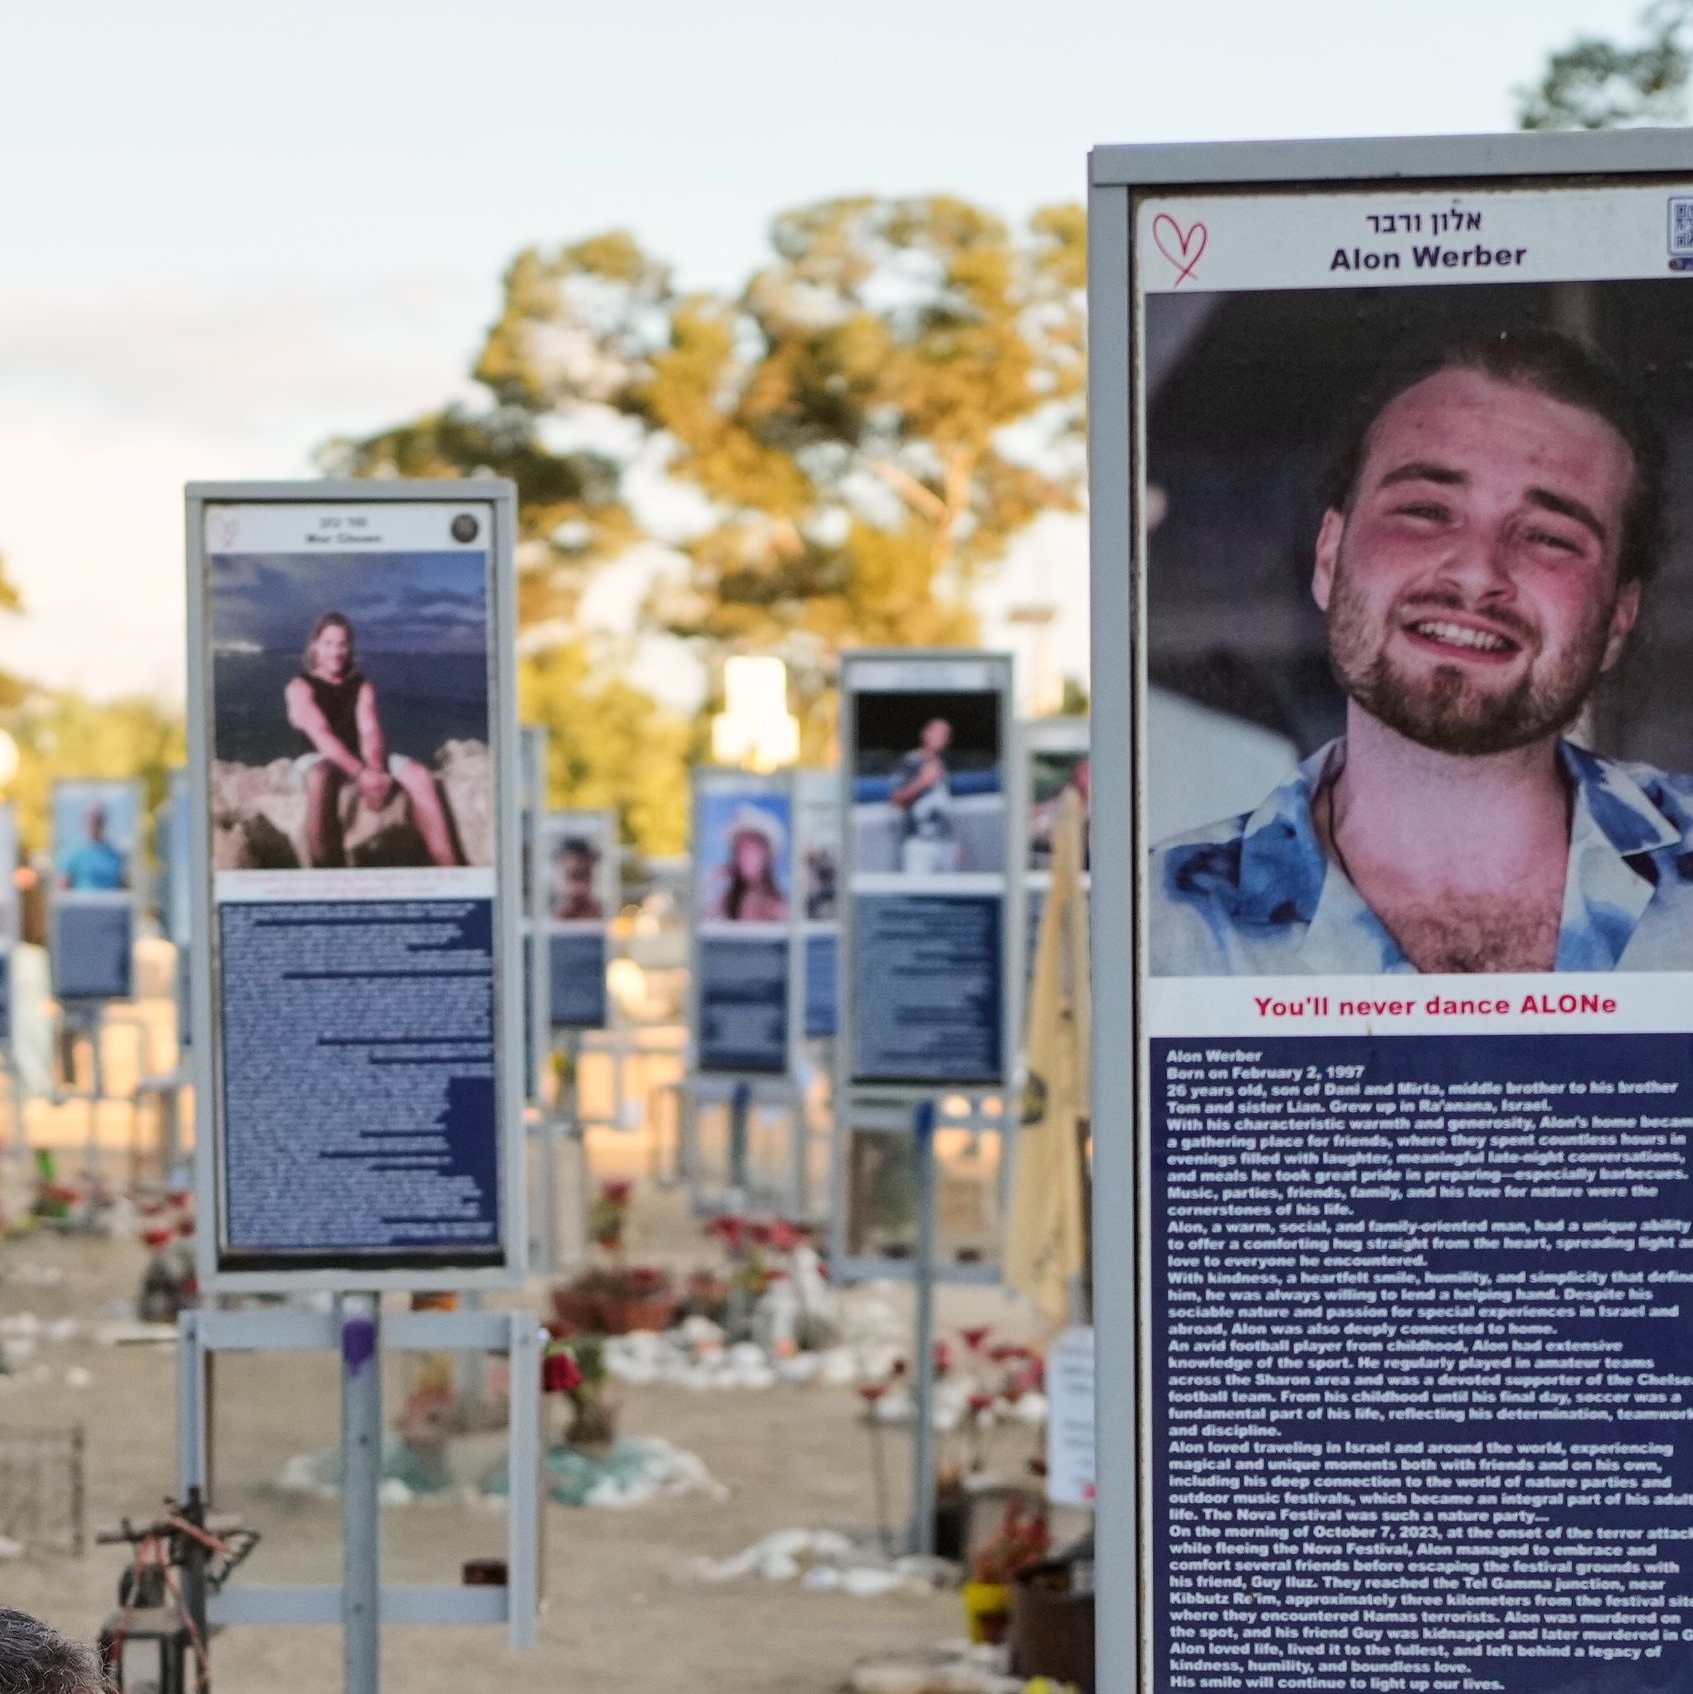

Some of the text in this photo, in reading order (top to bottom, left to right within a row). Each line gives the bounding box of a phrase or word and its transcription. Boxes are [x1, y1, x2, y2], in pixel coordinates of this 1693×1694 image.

[1366, 208, 1483, 236] אלון ורבר
[1330, 244, 1527, 271] Alon Werber
[1255, 994, 1618, 1017] You'll never dance ALONe
[1165, 1048, 1264, 1063] Alon Werber
[1165, 1064, 1366, 1082] Born on February 2, 1997
[1167, 1524, 1193, 1538] On
[1193, 1525, 1223, 1538] the
[1223, 1525, 1291, 1541] morning
[1291, 1525, 1311, 1538] of
[1311, 1524, 1379, 1539] October
[1379, 1525, 1397, 1540] 7,
[1398, 1525, 1444, 1541] 2023,
[1445, 1526, 1465, 1539] at
[1465, 1526, 1495, 1539] the
[1495, 1527, 1543, 1540] onset
[1543, 1526, 1564, 1539] of
[1564, 1526, 1595, 1540] the
[1595, 1527, 1646, 1540] terror
[1168, 1675, 1507, 1693] His smile will continue to light up our lives.
